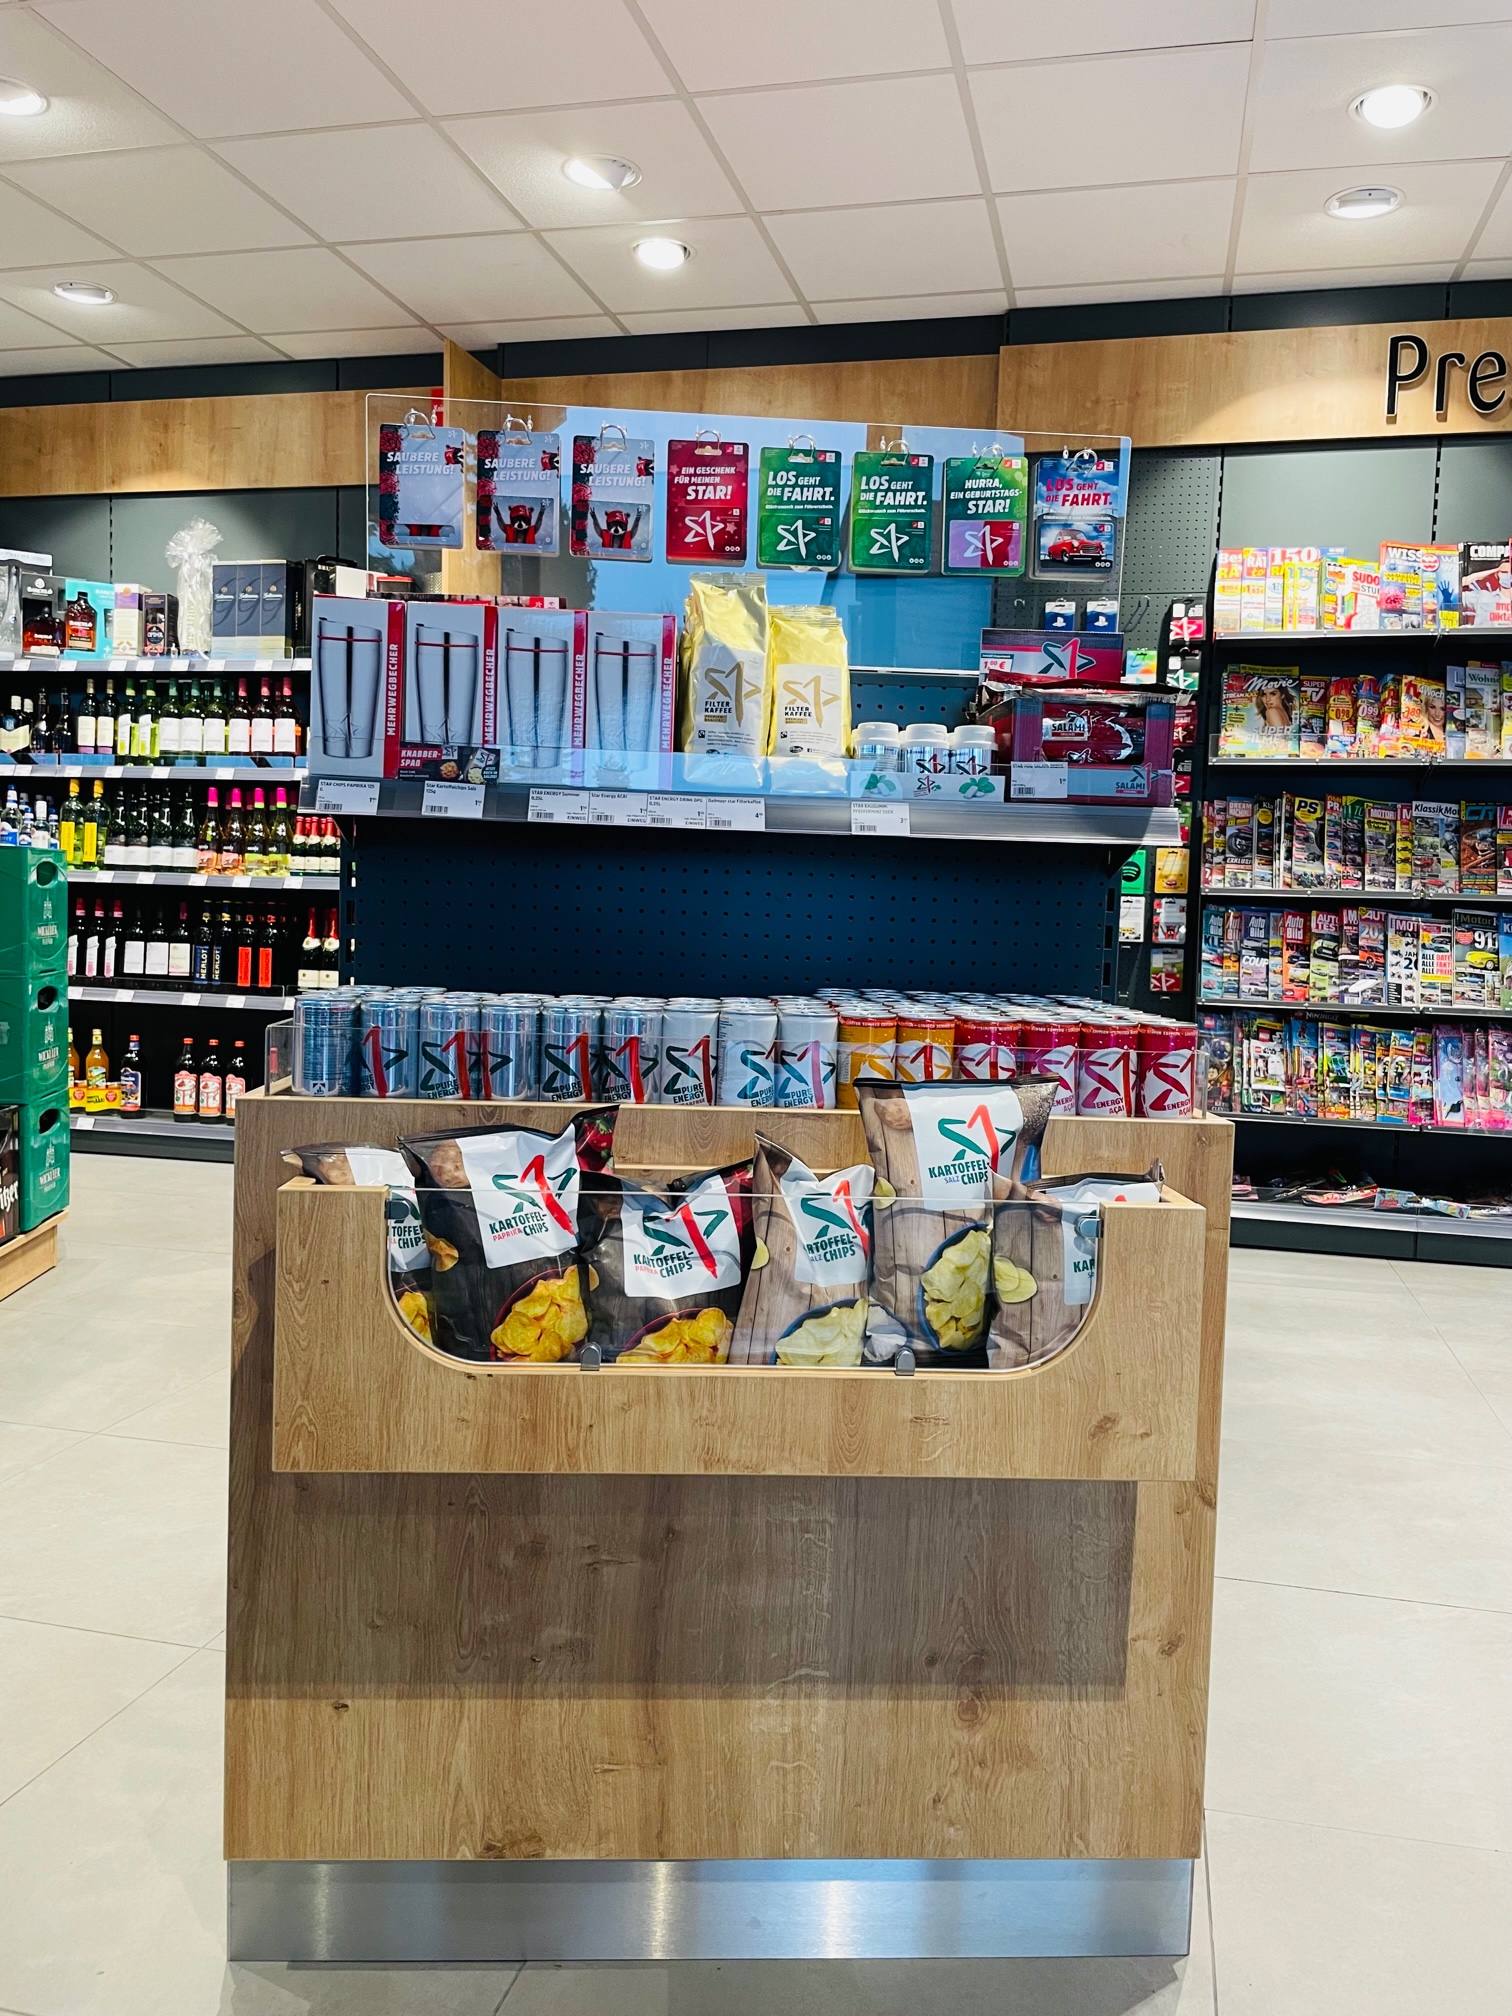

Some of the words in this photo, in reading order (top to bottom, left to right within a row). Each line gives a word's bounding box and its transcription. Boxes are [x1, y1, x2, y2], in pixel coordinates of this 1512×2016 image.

[387, 452, 439, 462] SAUBERE
[396, 463, 455, 475] LEISTUNG!
[484, 458, 535, 469] SAUBERE
[579, 463, 631, 474] SAUBERE
[493, 470, 551, 482] LEISTUNG!
[588, 475, 646, 487] LEISTUNG!
[690, 476, 720, 484] MEINEN
[767, 471, 796, 485] LOS
[798, 477, 821, 485] GEHT
[860, 476, 889, 490] LOS
[890, 481, 913, 490] GEHT
[965, 478, 1003, 489] HURRA,
[1046, 478, 1074, 492] LOS
[1076, 482, 1099, 491] GEHT
[686, 485, 733, 500] STAR!
[767, 488, 782, 496] DIE
[783, 488, 835, 501] FAHRT.
[860, 492, 874, 501] DIE
[875, 491, 928, 506] FAHRT.
[950, 491, 964, 499] EIN
[965, 489, 1023, 499] GEBURTSTAGS-
[1045, 494, 1060, 502] DIE
[1061, 492, 1113, 507] FAHRT.
[967, 499, 1011, 514] STAR!
[1271, 547, 1318, 562] 150
[386, 643, 399, 737] MEHRWEGBECHER
[1303, 680, 1325, 688] SUPER
[484, 648, 495, 748] MEHRWEGBECHER
[573, 653, 585, 750] MEHRWEGBECHER
[661, 656, 673, 750] MEHRWEGBECHER
[1051, 722, 1085, 732] SALAMI
[401, 749, 441, 758] KNABBER-
[1115, 781, 1146, 790] SALAMI
[1297, 800, 1319, 814] PS
[1250, 916, 1266, 928] Auto
[1285, 915, 1304, 928] Auto
[1250, 928, 1264, 938] Bild
[1286, 927, 1304, 939] Bild
[200, 948, 208, 979] MERLOT
[435, 1079, 458, 1091] PURE
[559, 1081, 582, 1091] PURE
[610, 1083, 631, 1093] PURE
[681, 1083, 704, 1094] PURE
[427, 1088, 460, 1100] ENERGY
[551, 1089, 583, 1102] ENERGY
[604, 1090, 632, 1102] ENERGY
[673, 1091, 705, 1104] ENERGY
[791, 1088, 812, 1099] PURE
[784, 1096, 814, 1108] ENERGY
[1096, 1097, 1124, 1108] ENERGY
[1167, 1098, 1191, 1110] ENERGY
[944, 1175, 960, 1184] SALZ
[962, 1170, 988, 1185] CHIPS
[489, 1212, 548, 1235] KARTOFFEL-
[492, 1228, 523, 1242] PAPRIKA
[523, 1222, 549, 1237] CHIPS
[633, 1251, 695, 1269] KARTOFFEL-
[823, 1245, 857, 1263] CHIPS
[635, 1265, 659, 1275] PAPRIKA
[660, 1261, 693, 1279] CHIPS
